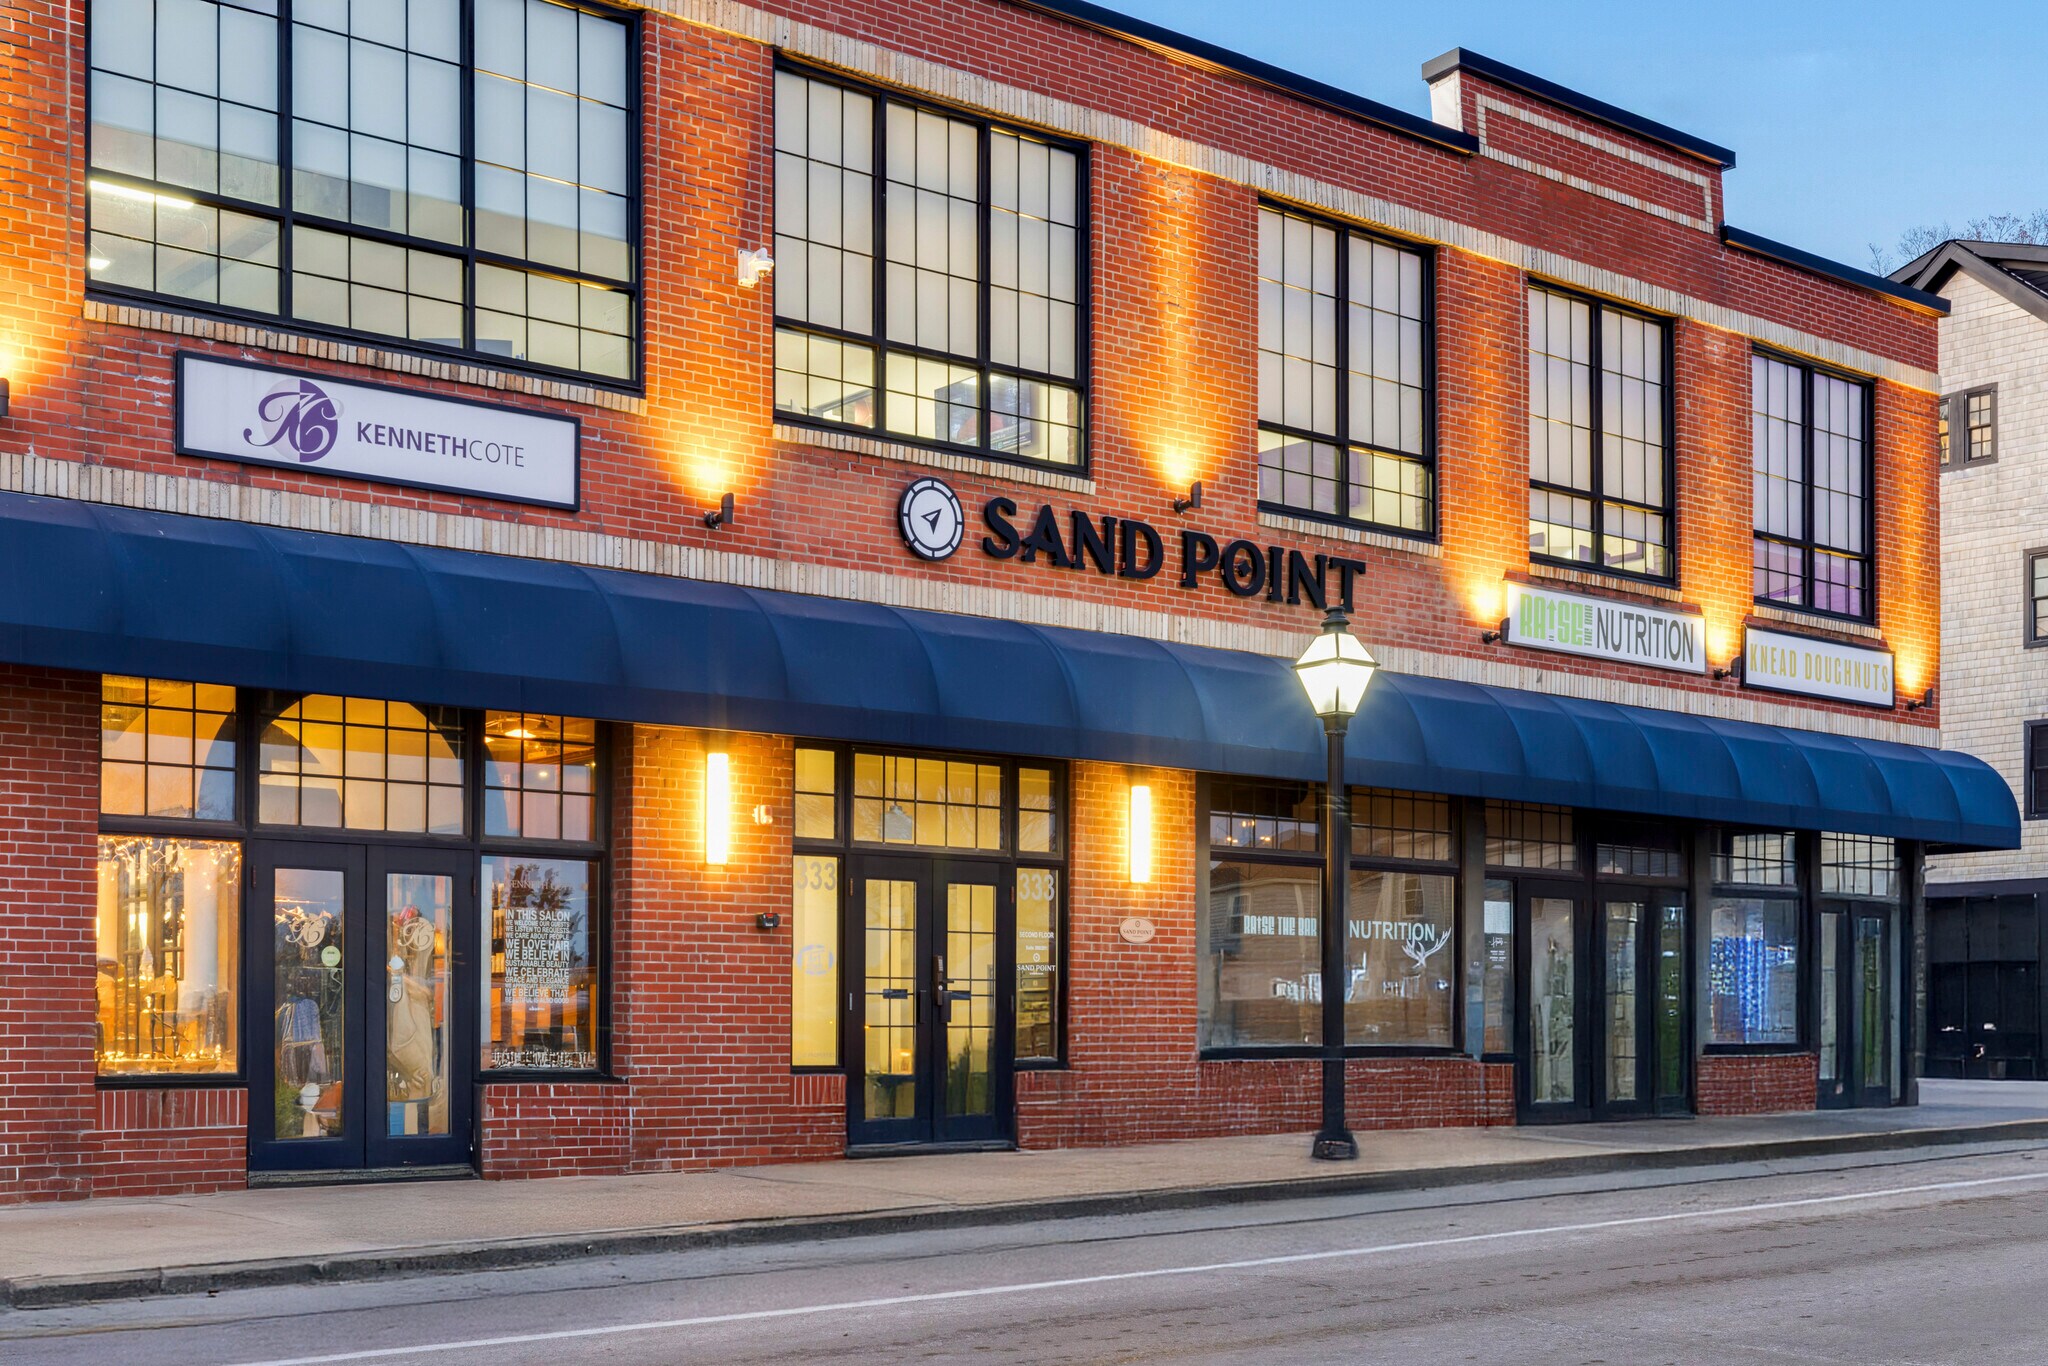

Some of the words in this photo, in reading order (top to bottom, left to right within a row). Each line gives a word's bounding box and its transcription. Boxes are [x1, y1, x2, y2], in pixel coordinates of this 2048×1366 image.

[982, 496, 1164, 580] SAND
[1180, 529, 1366, 614] POINT
[1596, 606, 1694, 664] NUTRITION
[1750, 643, 1798, 680] KNEAD
[1804, 652, 1889, 694] DOUGHNUTS
[796, 860, 836, 891] 333
[1018, 872, 1055, 902] 333
[505, 909, 514, 920] IN
[516, 909, 537, 920] THIS
[539, 910, 570, 922] SALON
[1277, 915, 1296, 936] THE
[1297, 917, 1317, 937] BAR
[1349, 919, 1435, 942] NUTRITION
[549, 933, 570, 941] PEOPLE
[1038, 931, 1054, 939] FLOOR
[505, 939, 520, 949] WE
[522, 939, 546, 950] LOVE
[548, 940, 570, 951] HAIR
[505, 949, 520, 959] WE
[522, 949, 559, 961] BELIEVE
[560, 950, 570, 962] IN
[505, 959, 545, 968] SUSTAINABLE
[546, 960, 570, 969] BEAUTY
[1035, 964, 1056, 972] POINT
[505, 966, 519, 977] WE
[520, 967, 570, 978] CELEBRATE
[525, 976, 538, 984] AND
[539, 977, 569, 985] ELEGANCE
[505, 988, 517, 996] WE
[518, 988, 549, 998] BELIEVE
[550, 989, 569, 998] THAT
